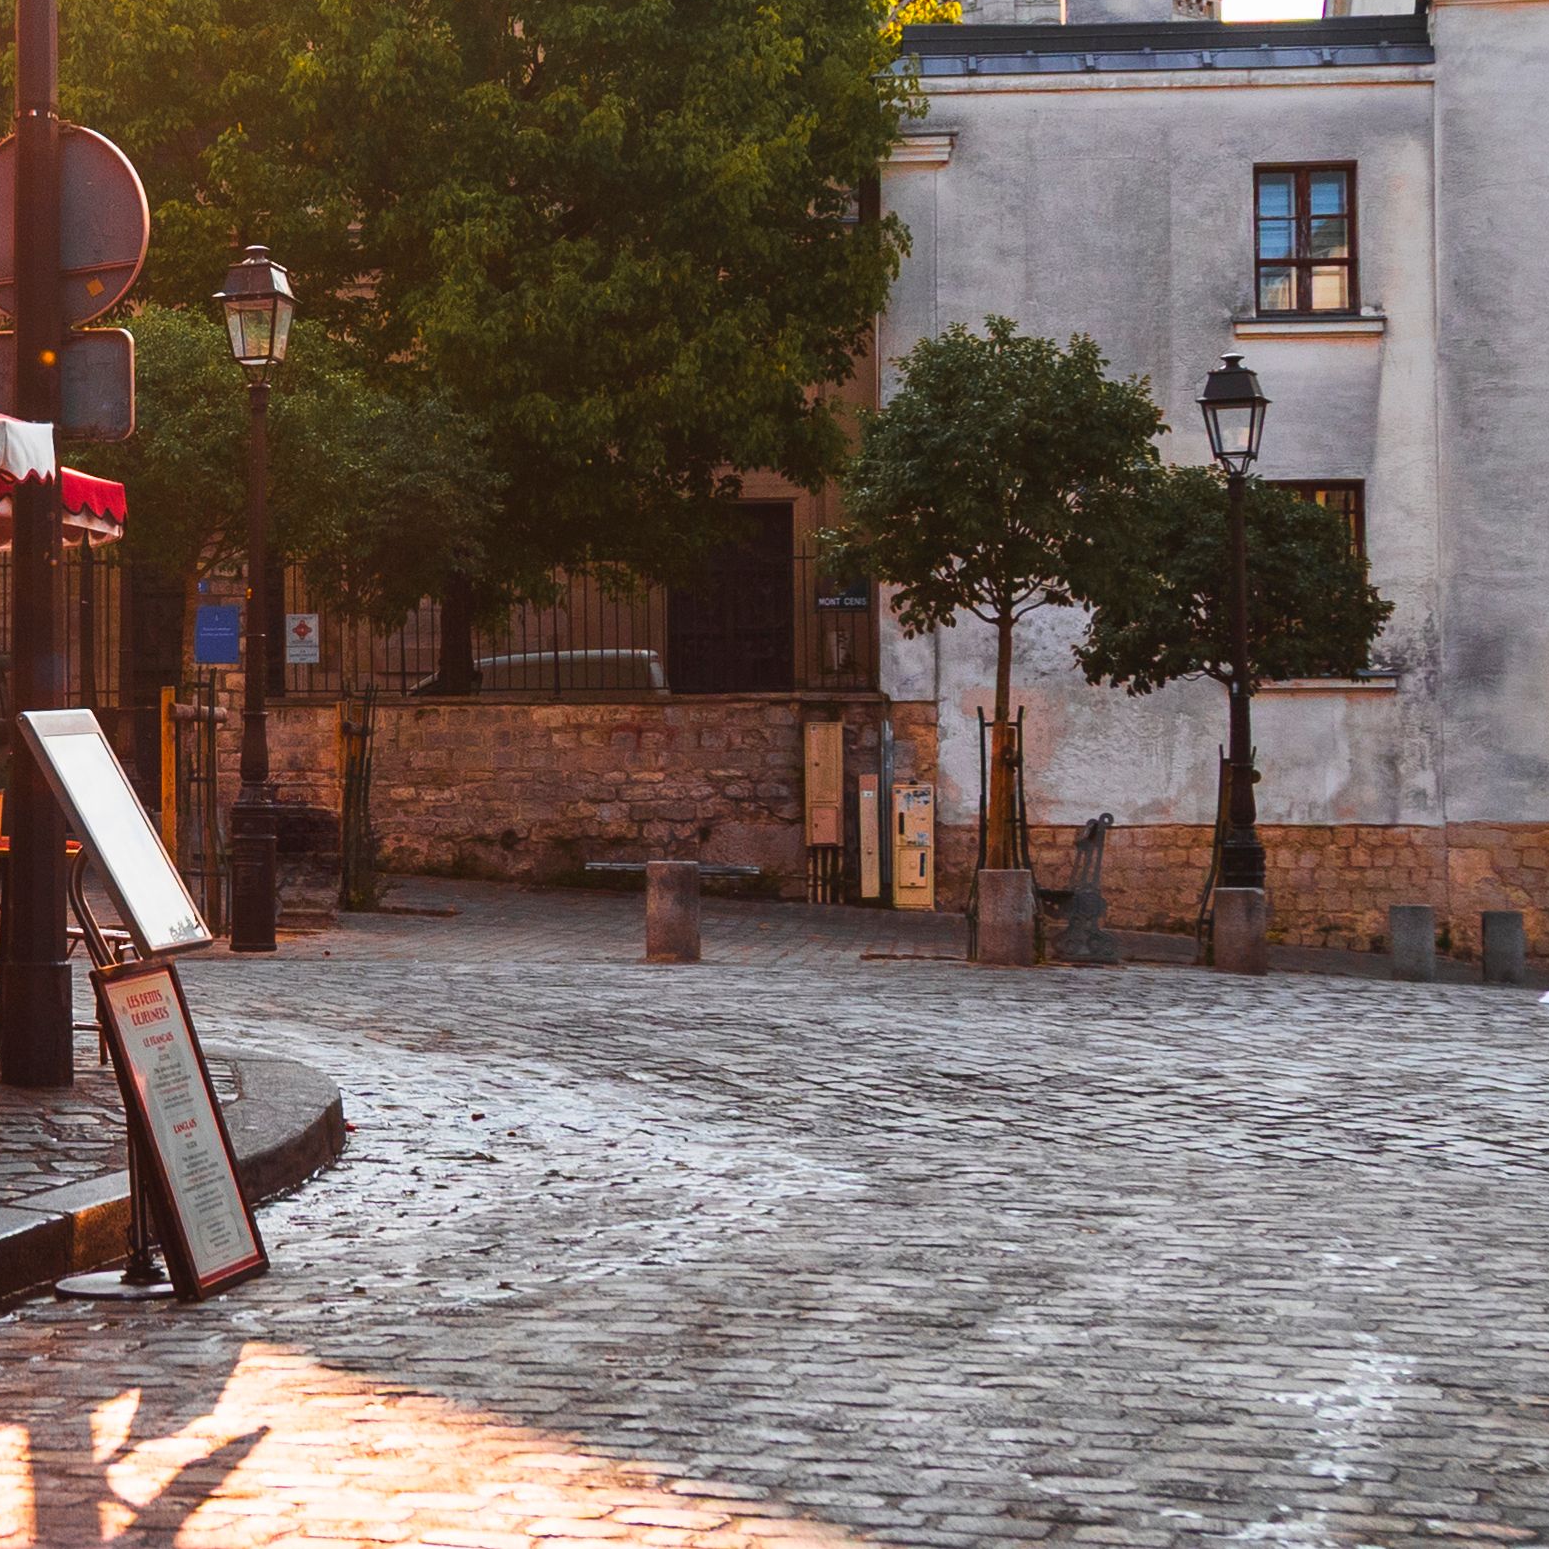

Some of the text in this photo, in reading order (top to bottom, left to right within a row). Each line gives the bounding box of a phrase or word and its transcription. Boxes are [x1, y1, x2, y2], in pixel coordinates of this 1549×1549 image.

[818, 597, 866, 606] MONT CENIS
[126, 994, 140, 1009] LES
